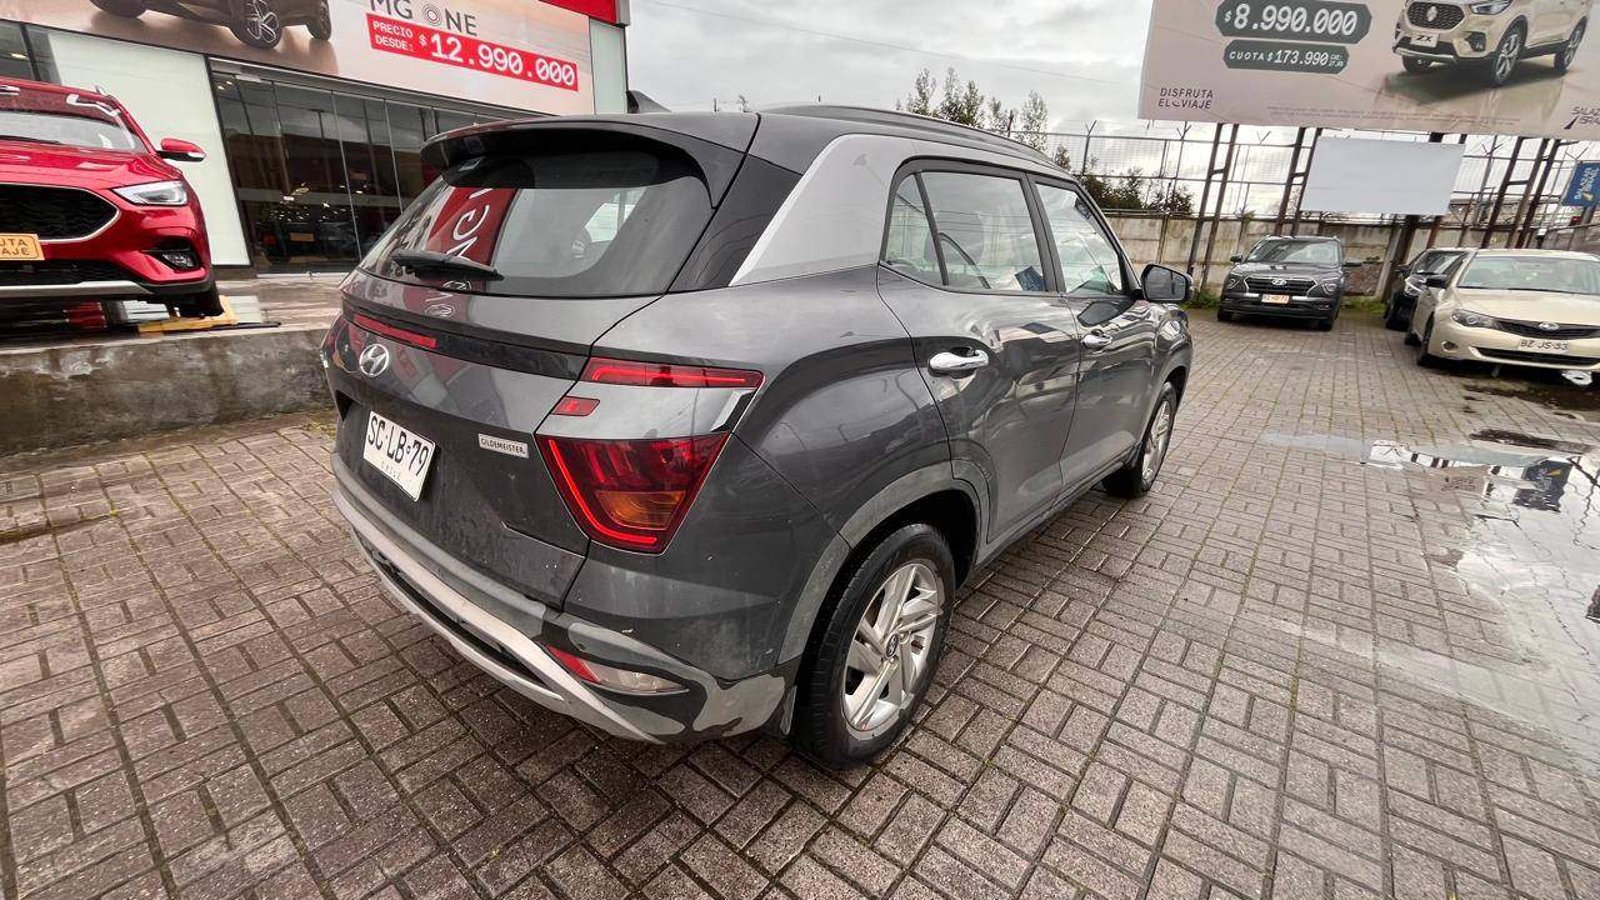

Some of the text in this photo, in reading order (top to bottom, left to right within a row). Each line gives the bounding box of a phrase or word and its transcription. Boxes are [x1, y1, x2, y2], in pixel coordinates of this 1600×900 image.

[370, 0, 413, 19] MG
[373, 20, 413, 38] PRECIO
[375, 34, 414, 52] DESDE:
[1229, 51, 1264, 61] CUOTA
[1160, 87, 1214, 99] DISFRUTA
[1159, 98, 1211, 110] EL VIAJE
